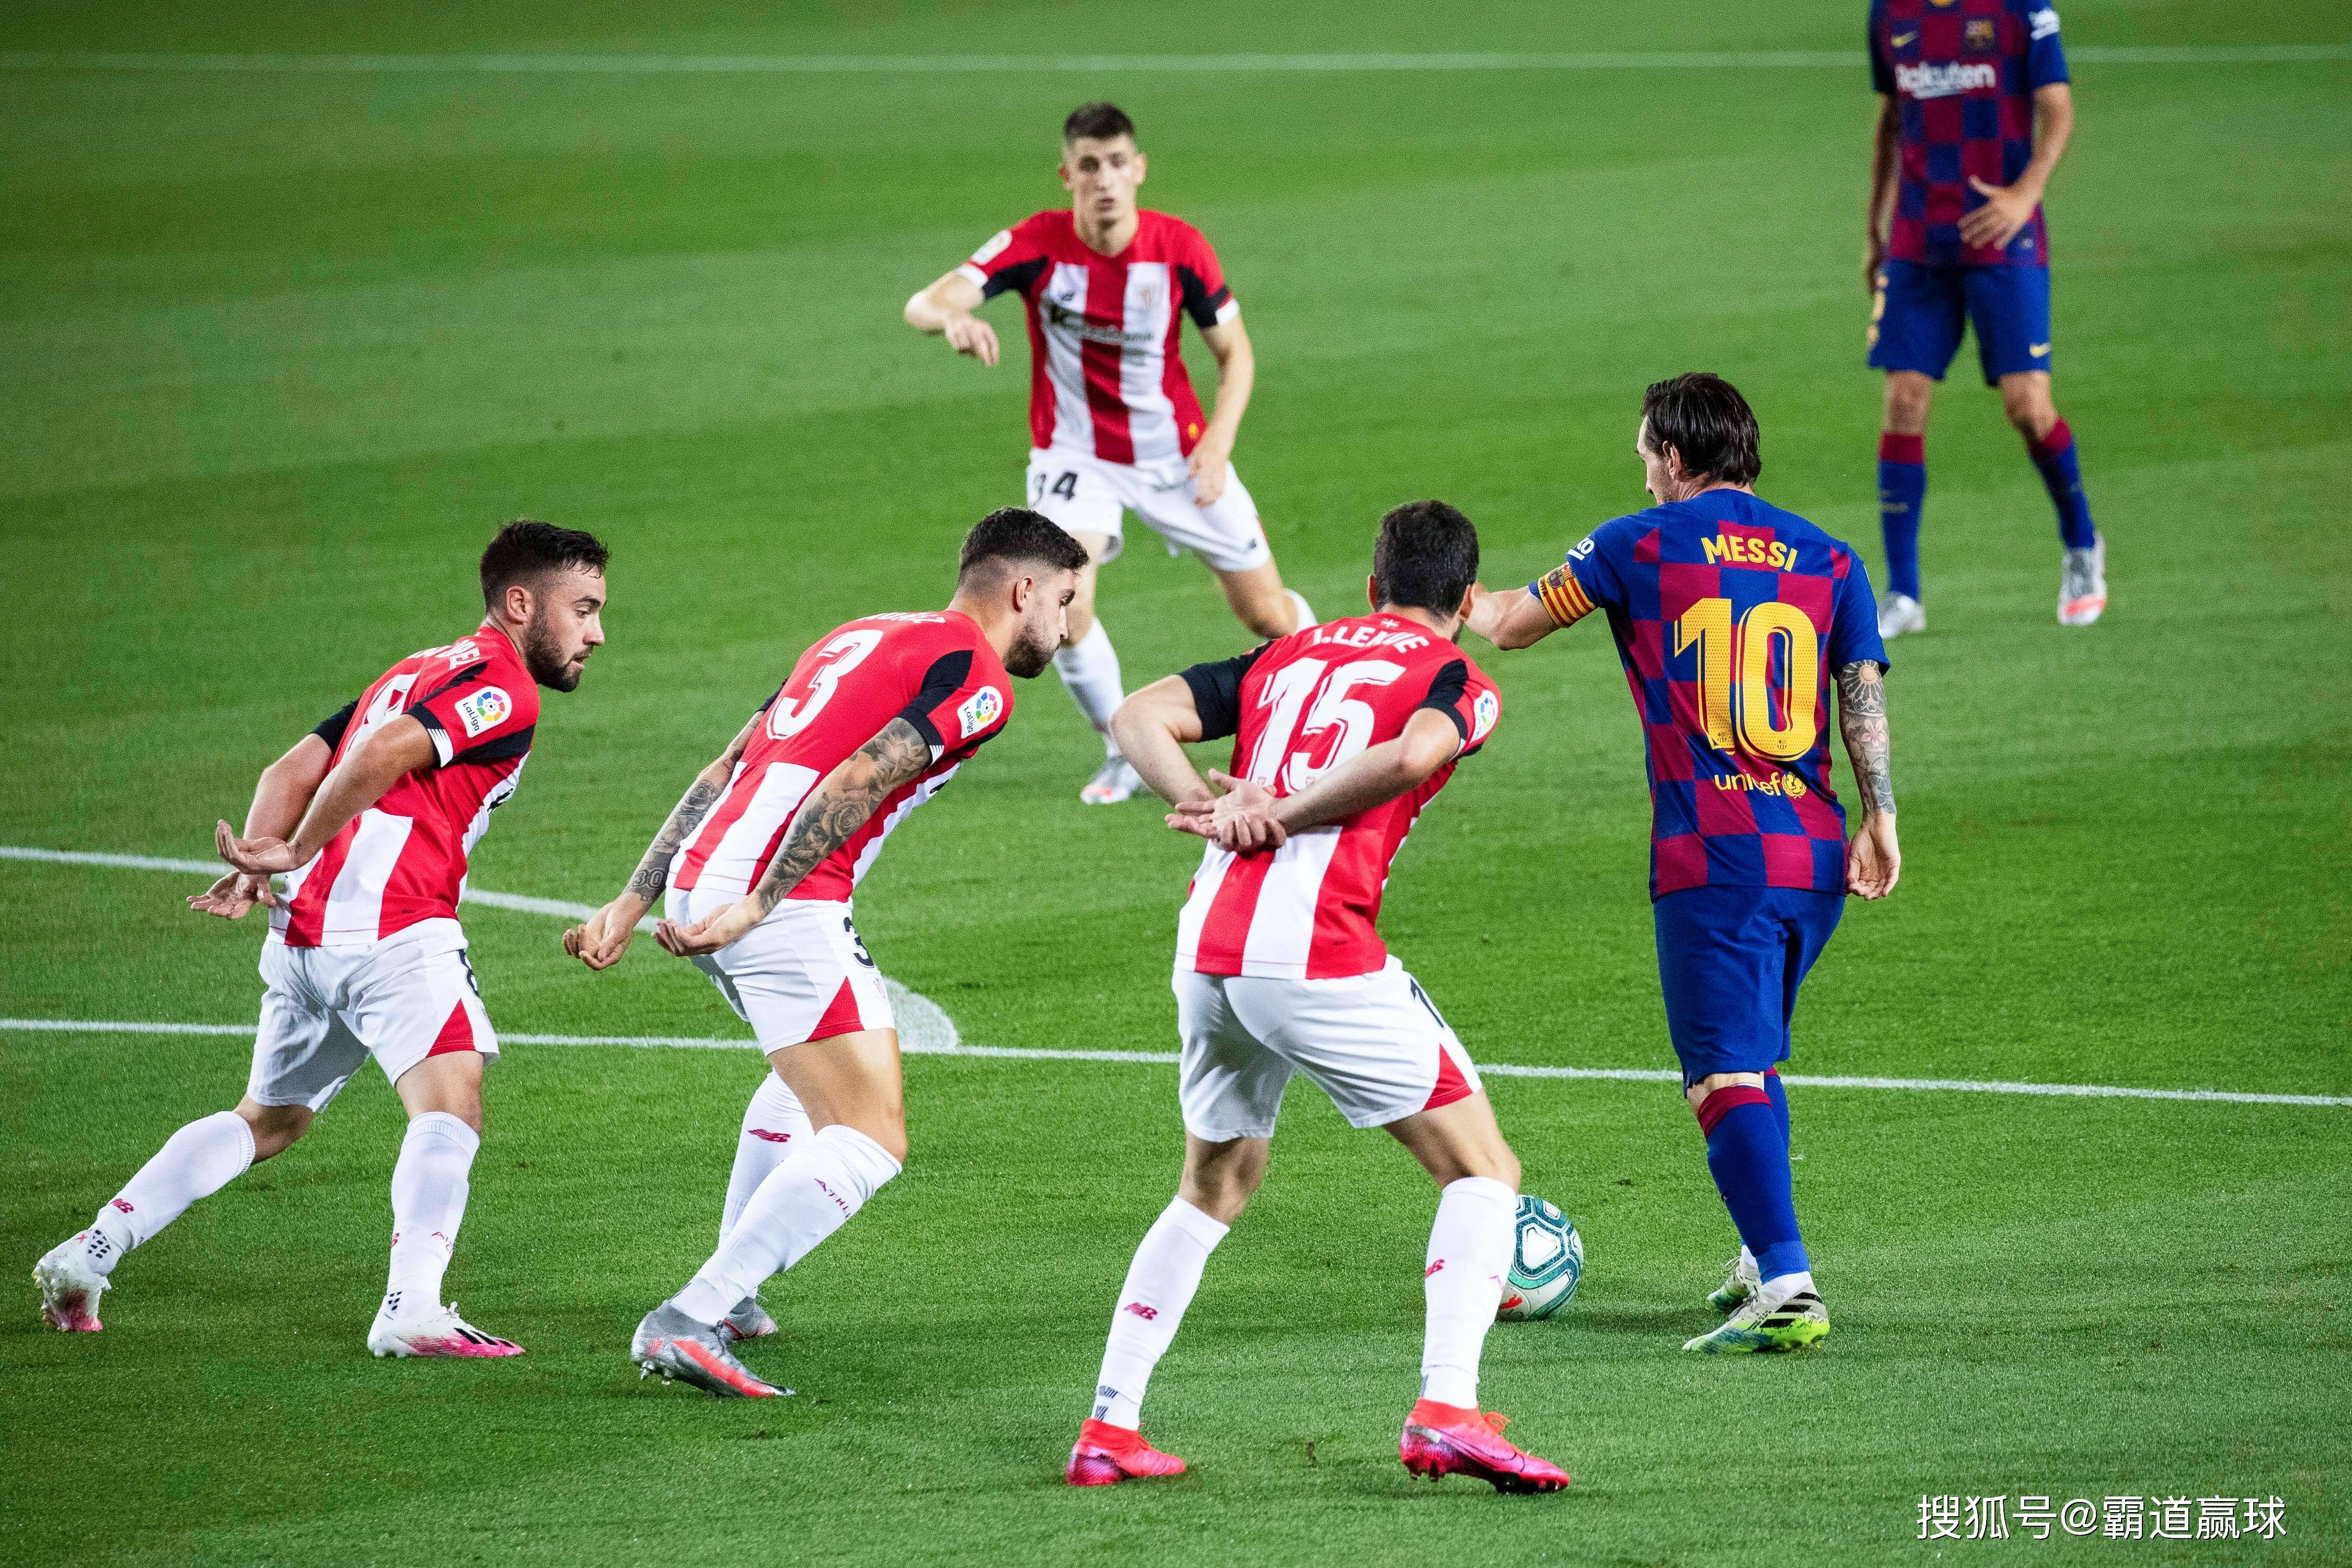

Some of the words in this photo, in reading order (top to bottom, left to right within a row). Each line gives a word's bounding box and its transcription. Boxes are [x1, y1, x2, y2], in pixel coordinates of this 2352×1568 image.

[1701, 534, 1797, 572] MESSI
[463, 702, 480, 731] LaLiga
[766, 629, 884, 740] 3
[1674, 597, 1818, 762] 10
[963, 706, 975, 733] LaLiga
[1246, 657, 1407, 794] 15
